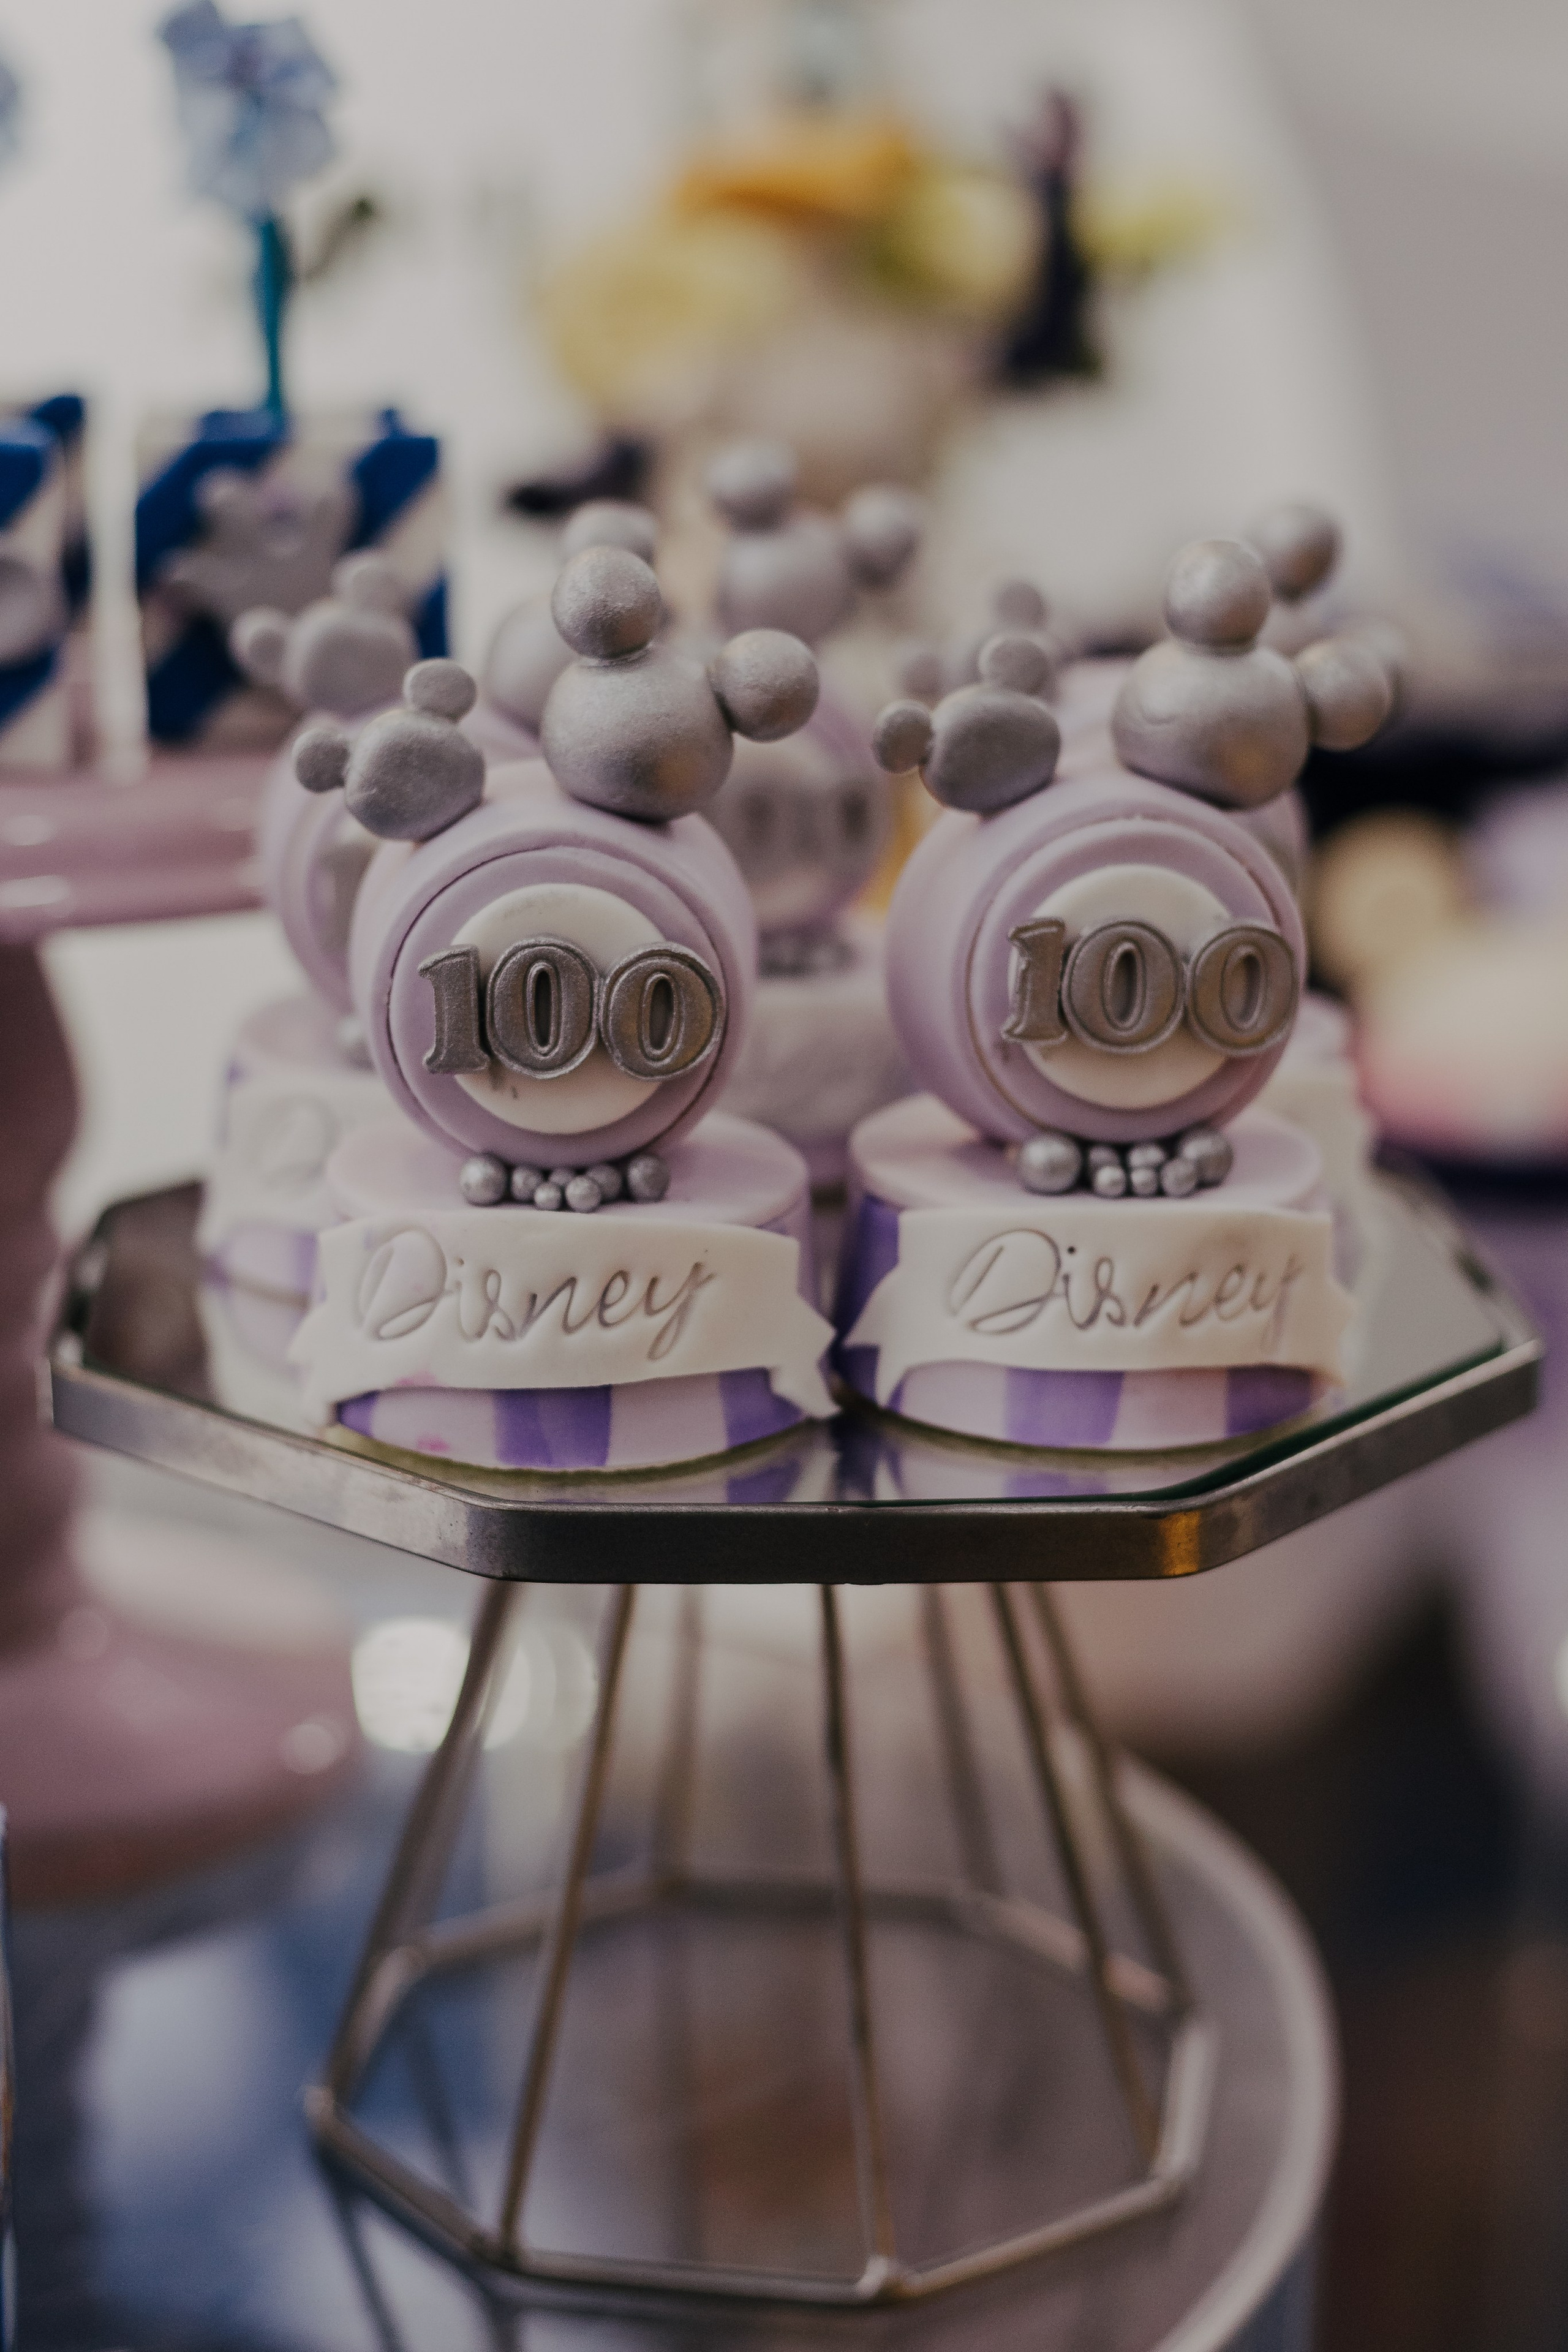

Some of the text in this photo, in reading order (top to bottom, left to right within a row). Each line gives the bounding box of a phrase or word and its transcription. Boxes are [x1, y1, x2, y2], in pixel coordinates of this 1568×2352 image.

[417, 936, 726, 1080] 100
[1001, 917, 1300, 1057] 100
[358, 1227, 718, 1361] Disney
[947, 1227, 1305, 1352] Disney
